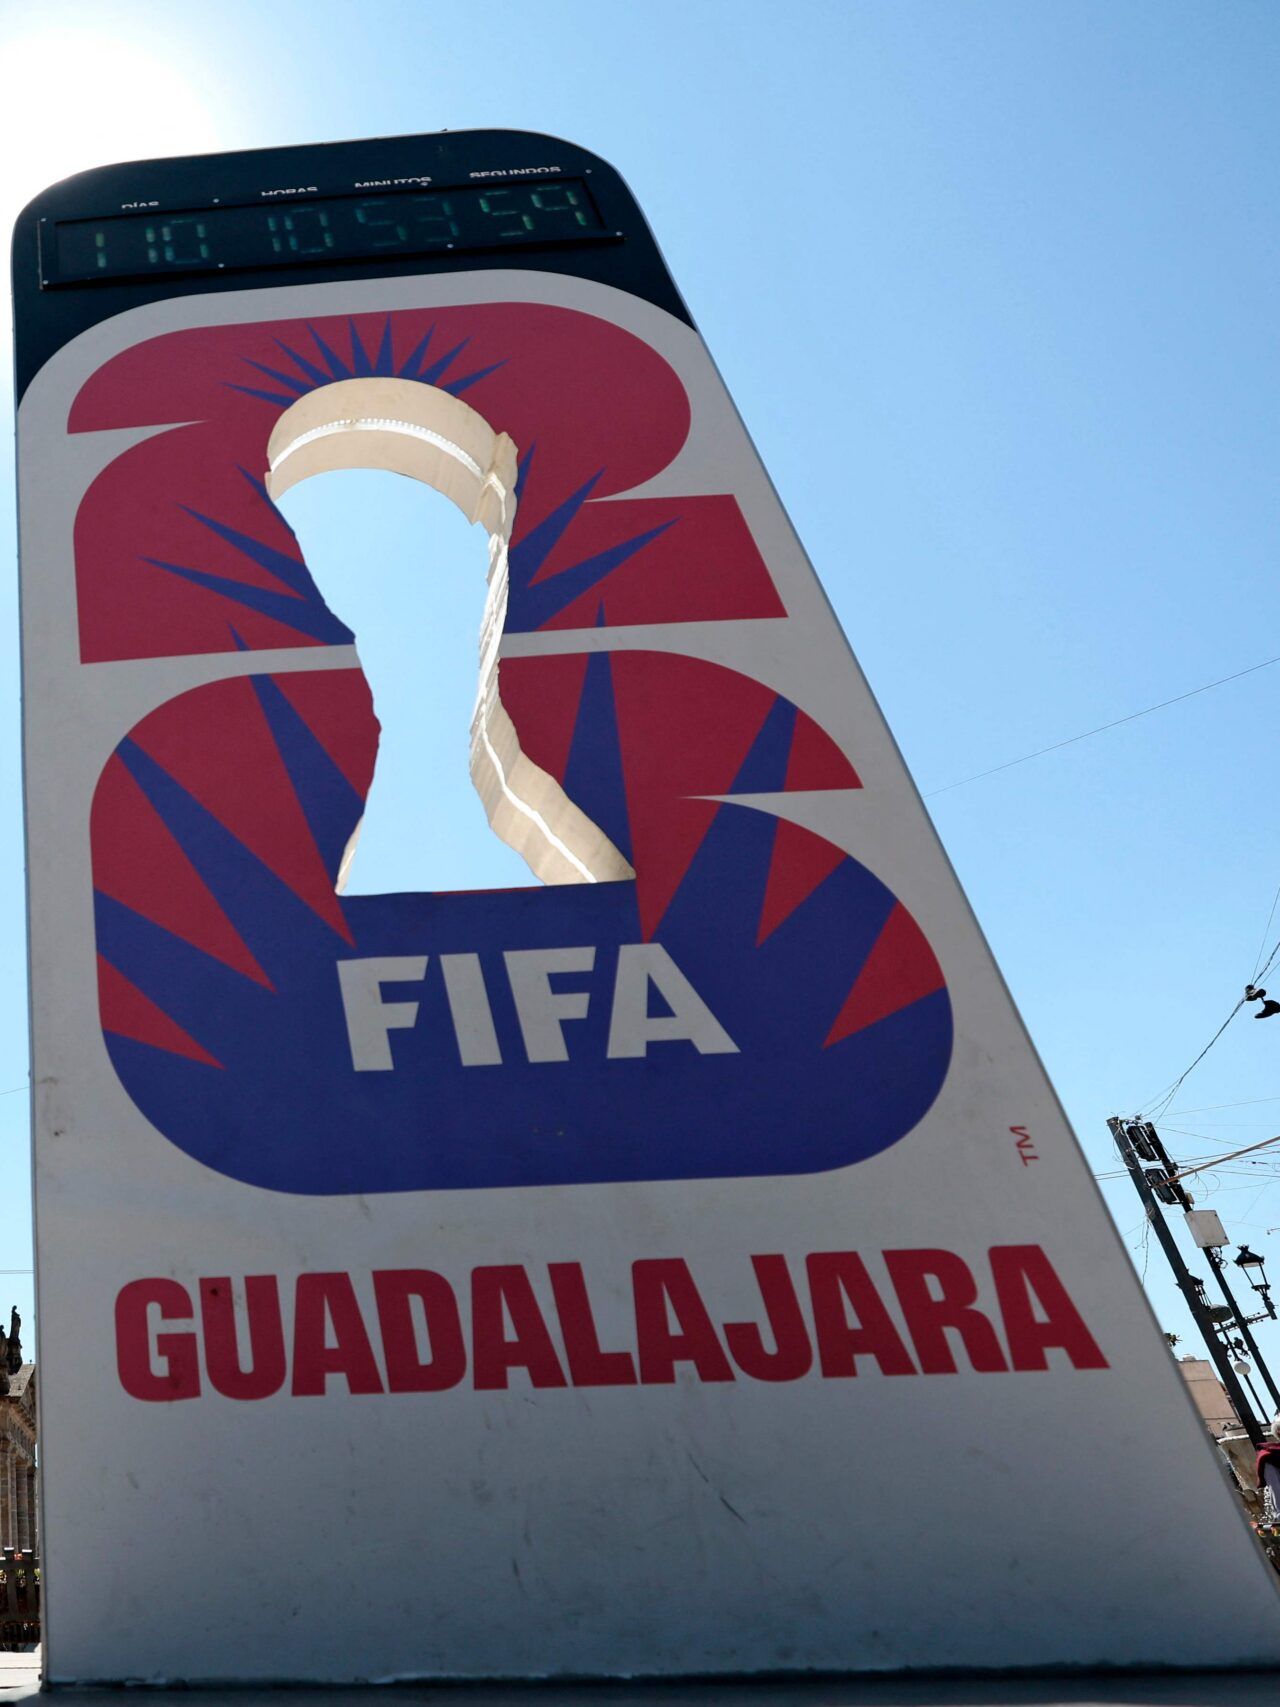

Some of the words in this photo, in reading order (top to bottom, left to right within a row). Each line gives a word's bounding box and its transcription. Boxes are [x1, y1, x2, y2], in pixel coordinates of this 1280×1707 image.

[268, 208, 333, 254] 10
[355, 198, 459, 247] 53
[479, 185, 587, 236] 59
[336, 942, 741, 1072] FIFA
[114, 1243, 1110, 1402] GUADALAJARA
